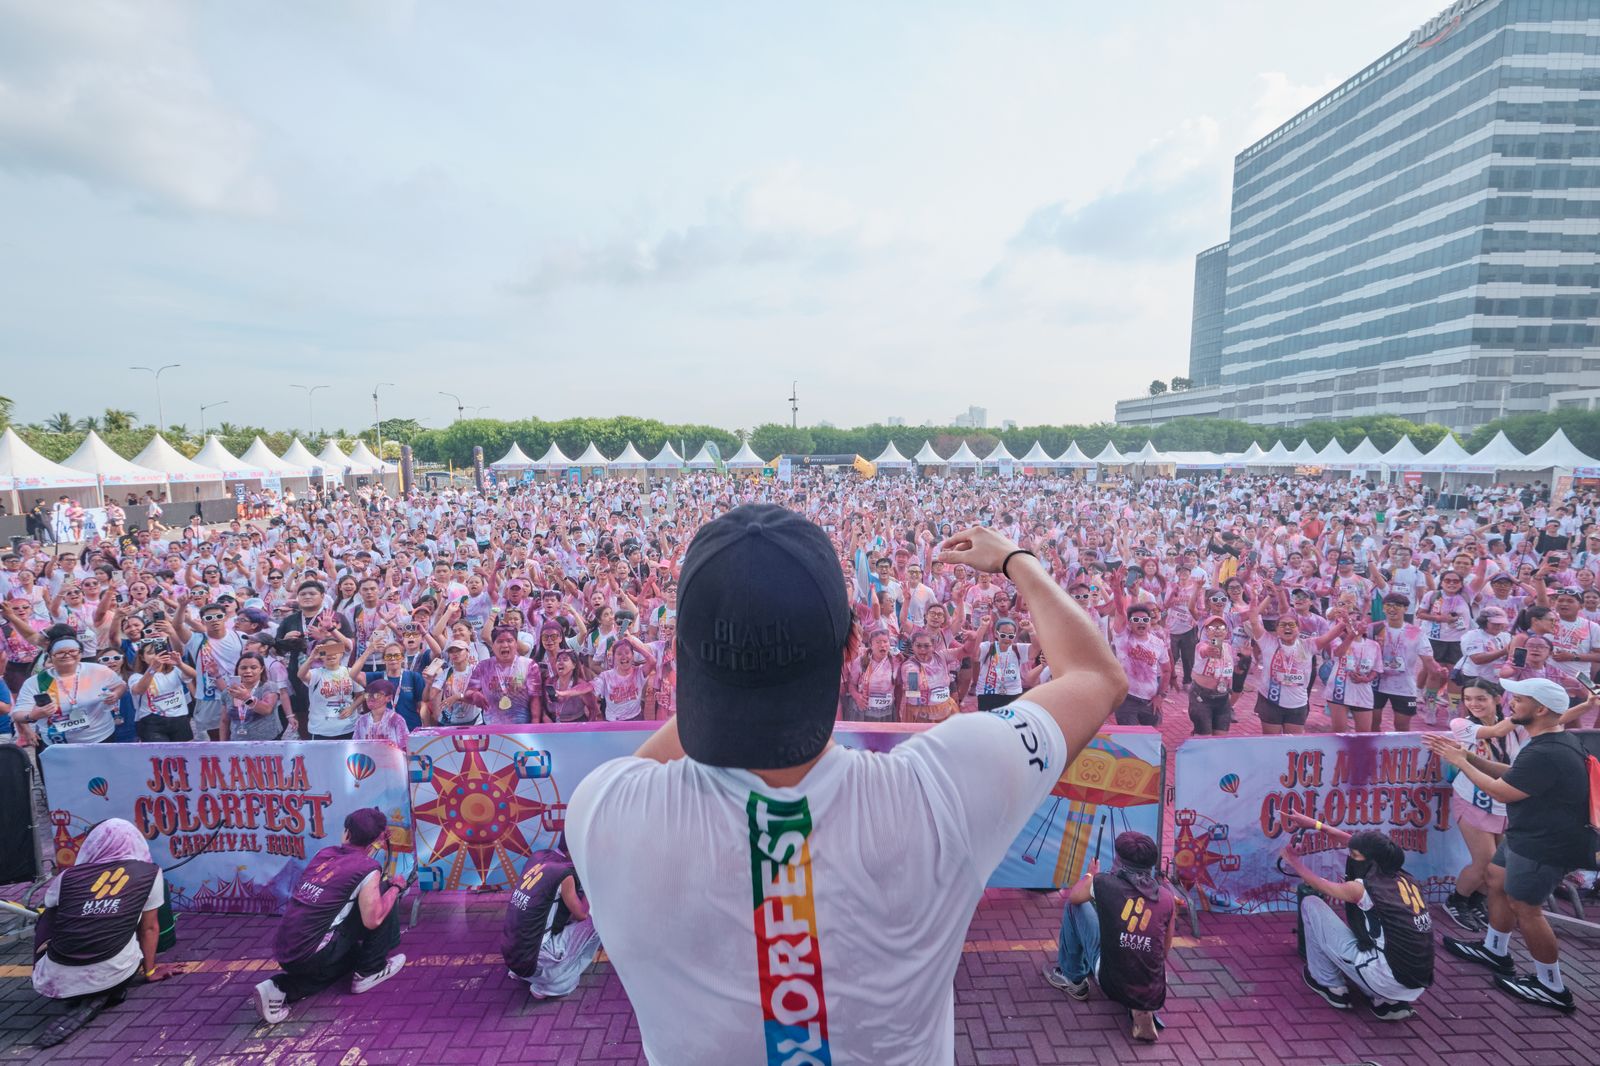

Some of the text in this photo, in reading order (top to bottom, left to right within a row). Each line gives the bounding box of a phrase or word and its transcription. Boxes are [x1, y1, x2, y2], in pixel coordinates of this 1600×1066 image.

[714, 617, 791, 648] BLACK
[699, 640, 807, 673] OCTOPUS
[61, 718, 86, 728] 7008
[146, 755, 312, 793] JCI MANILA
[1279, 750, 1325, 788] JCI
[134, 793, 333, 841] COLORFEST
[1260, 786, 1454, 839] COLORFEST
[169, 833, 306, 860] CARNIVAL RUN
[300, 882, 324, 897] HYVE
[512, 889, 531, 904] HYVE
[81, 907, 120, 916] SPORTS
[83, 899, 121, 910] HYVE
[1119, 932, 1152, 946] HYVE
[1119, 941, 1152, 952] SPORTS
